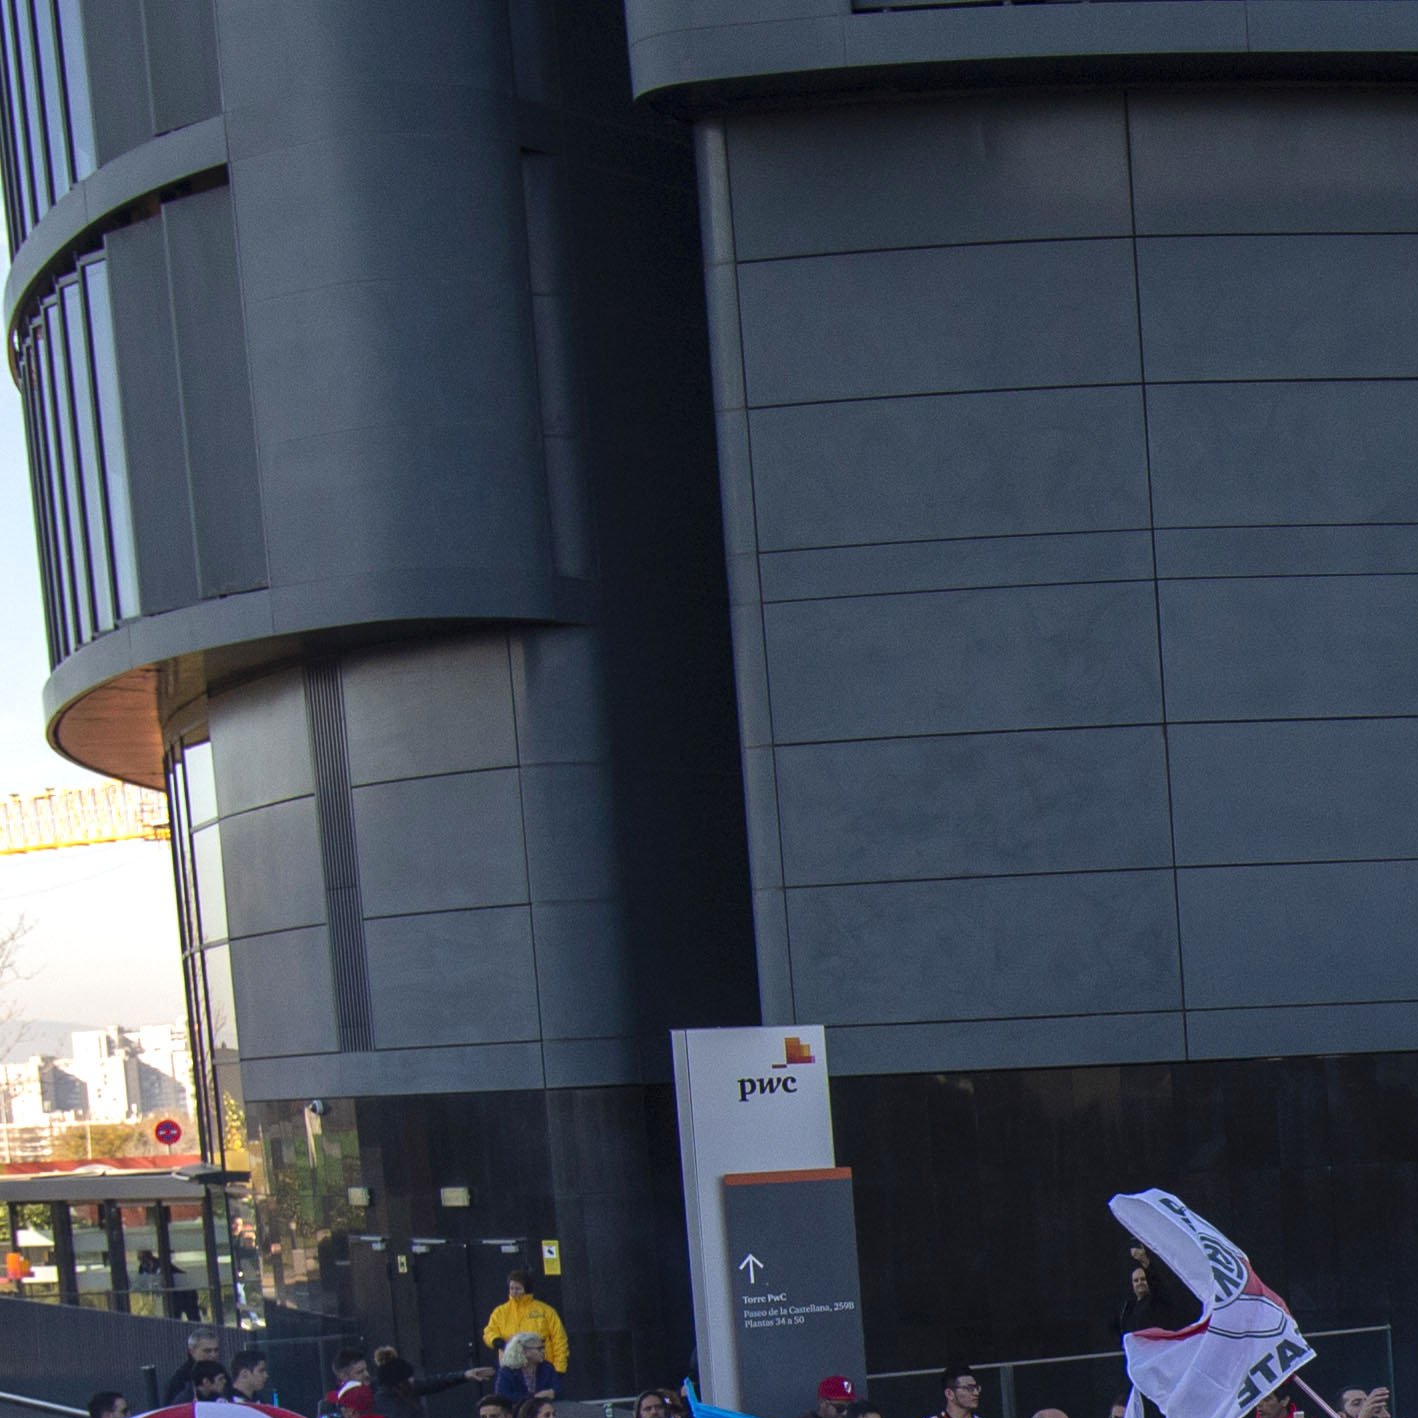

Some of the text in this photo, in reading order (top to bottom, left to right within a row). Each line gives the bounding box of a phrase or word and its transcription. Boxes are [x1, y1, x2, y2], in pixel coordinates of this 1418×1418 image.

[737, 1074, 797, 1102] pwc
[743, 1292, 787, 1304] Torre PwC
[743, 1309, 766, 1319] Paseo
[769, 1308, 779, 1316] de
[780, 1307, 787, 1315] la
[789, 1303, 832, 1315] Castellana,
[744, 1318, 774, 1328] Plantas
[794, 1316, 805, 1325] 50
